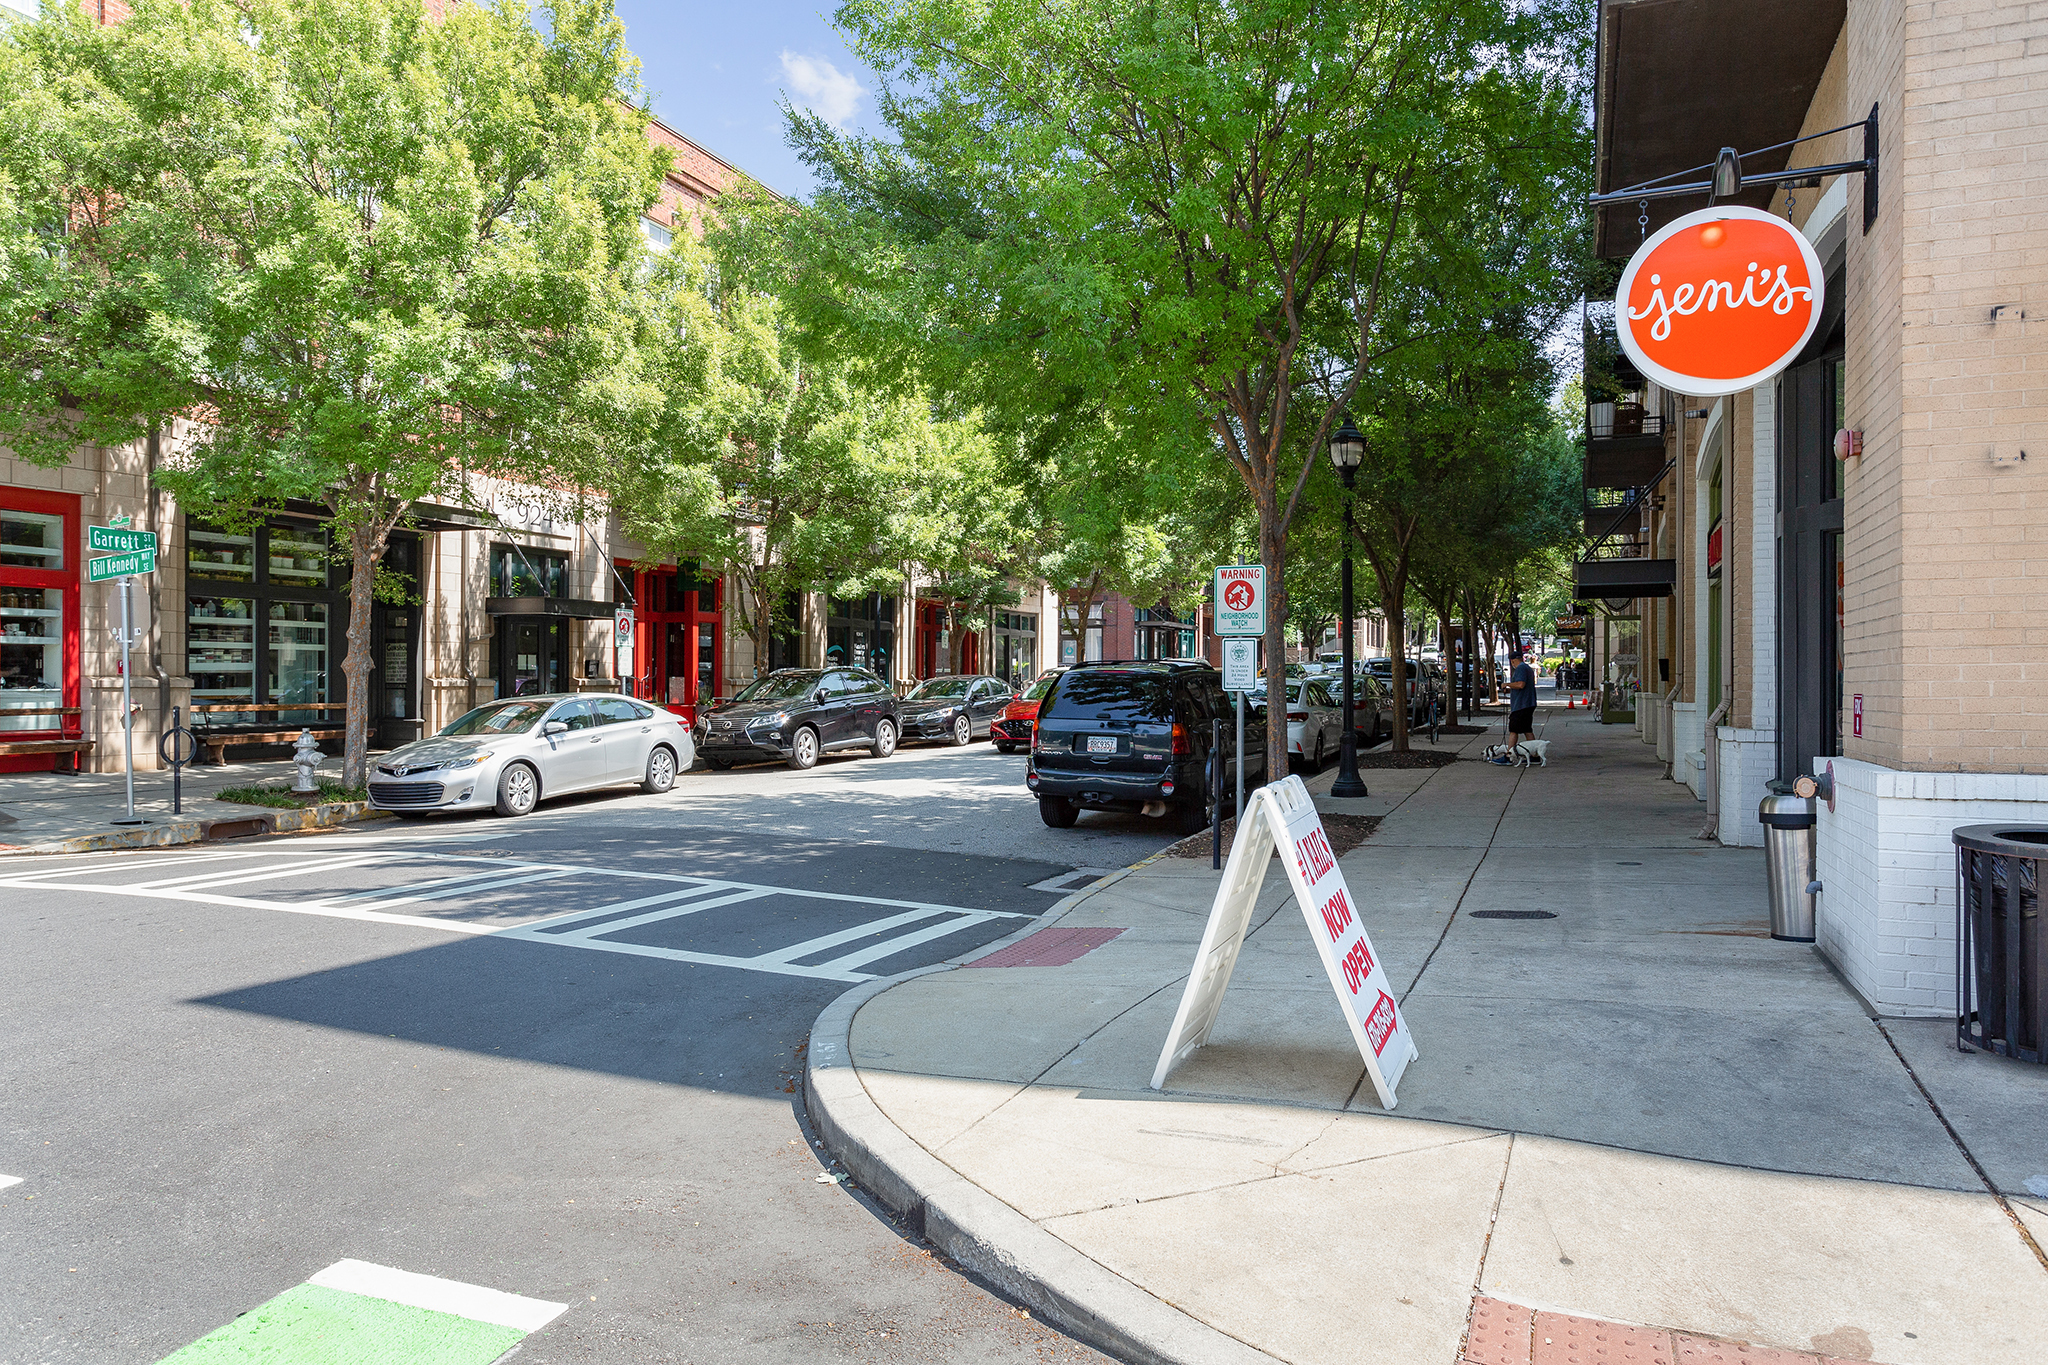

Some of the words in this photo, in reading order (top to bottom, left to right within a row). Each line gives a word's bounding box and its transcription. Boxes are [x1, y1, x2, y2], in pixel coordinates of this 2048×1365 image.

[1628, 262, 1813, 342] jeni's
[517, 504, 553, 528] 924
[94, 530, 139, 550] Garrett
[143, 534, 151, 542] ST
[92, 560, 106, 576] Bill
[107, 556, 139, 573] Kennedy
[141, 552, 150, 560] WAY
[143, 562, 149, 571] SE
[1220, 569, 1260, 580] WARNING
[1220, 612, 1259, 620] NEIGHBORHOOD
[1231, 619, 1248, 627] WATCH
[1854, 698, 1862, 715] FDC
[1303, 827, 1334, 882] NAILS
[1321, 888, 1353, 943] NOW
[1341, 936, 1375, 995] OPEN
